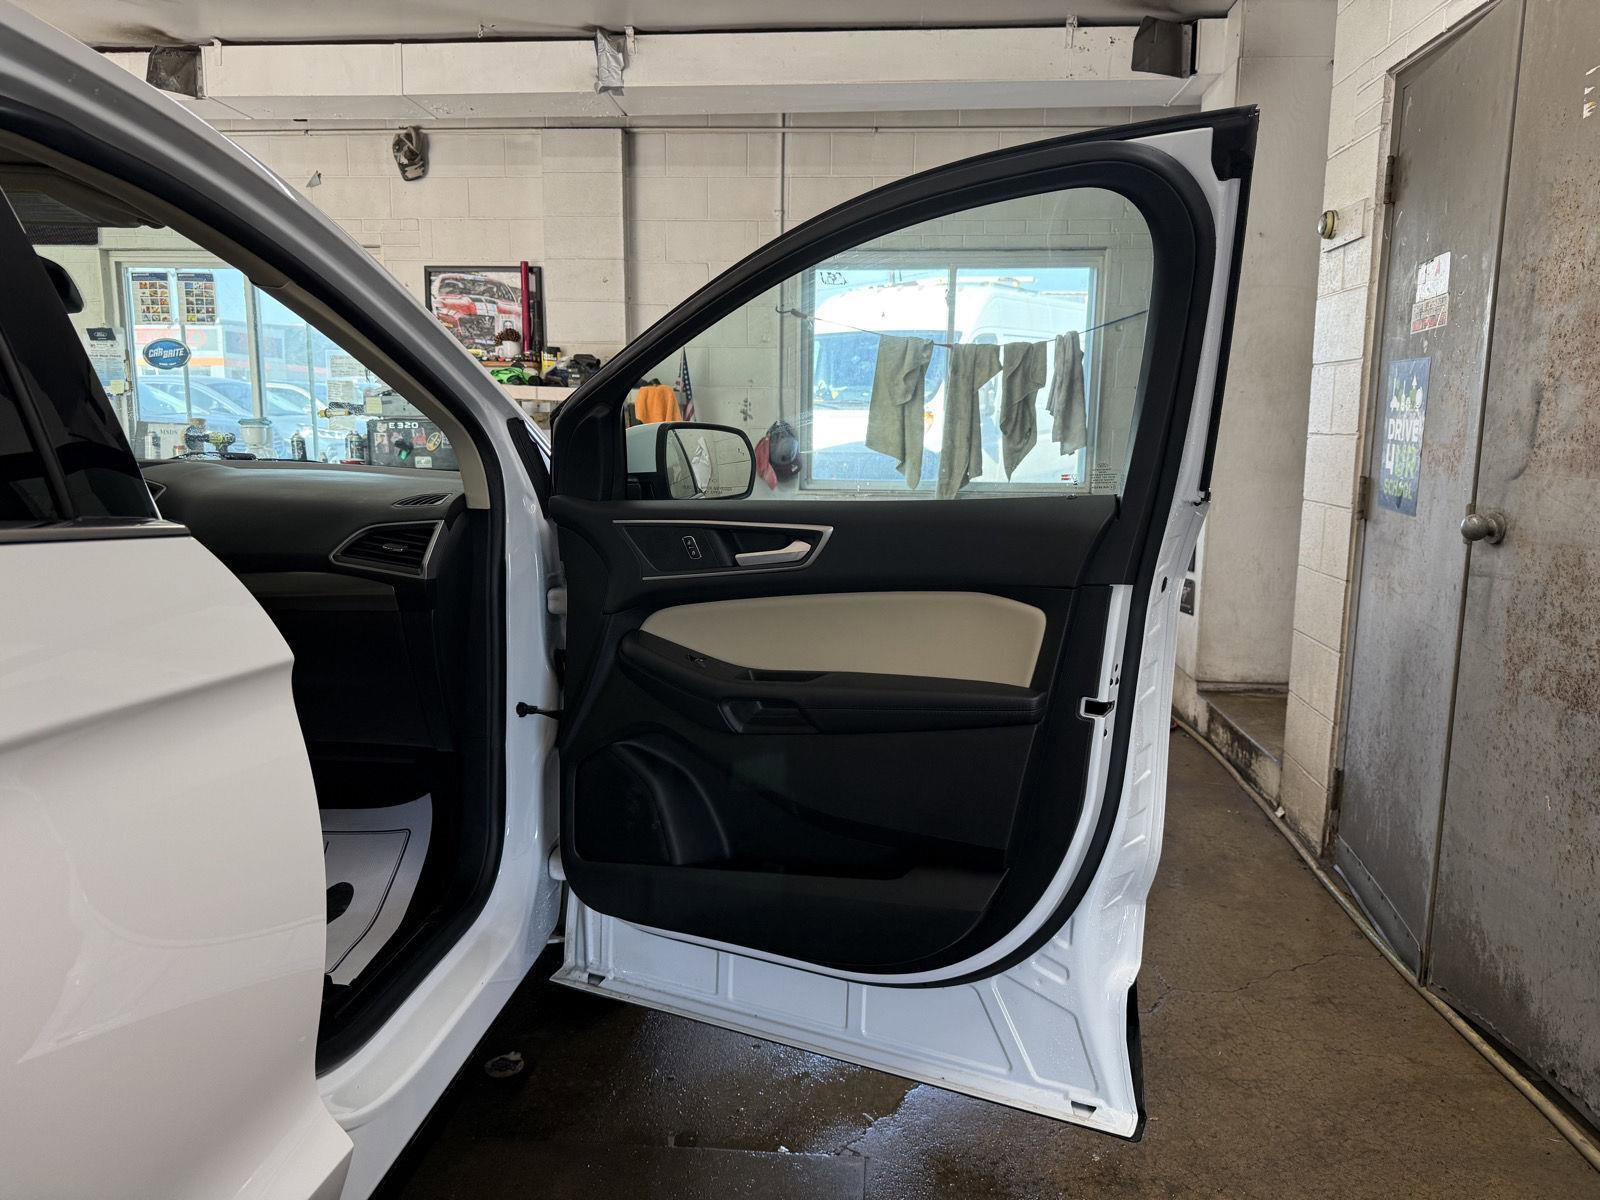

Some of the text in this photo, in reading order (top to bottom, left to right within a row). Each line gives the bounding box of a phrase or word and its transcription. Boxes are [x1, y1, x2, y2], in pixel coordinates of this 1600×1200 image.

[148, 347, 185, 359] CAR BRITE
[1387, 418, 1420, 443] DRIVE
